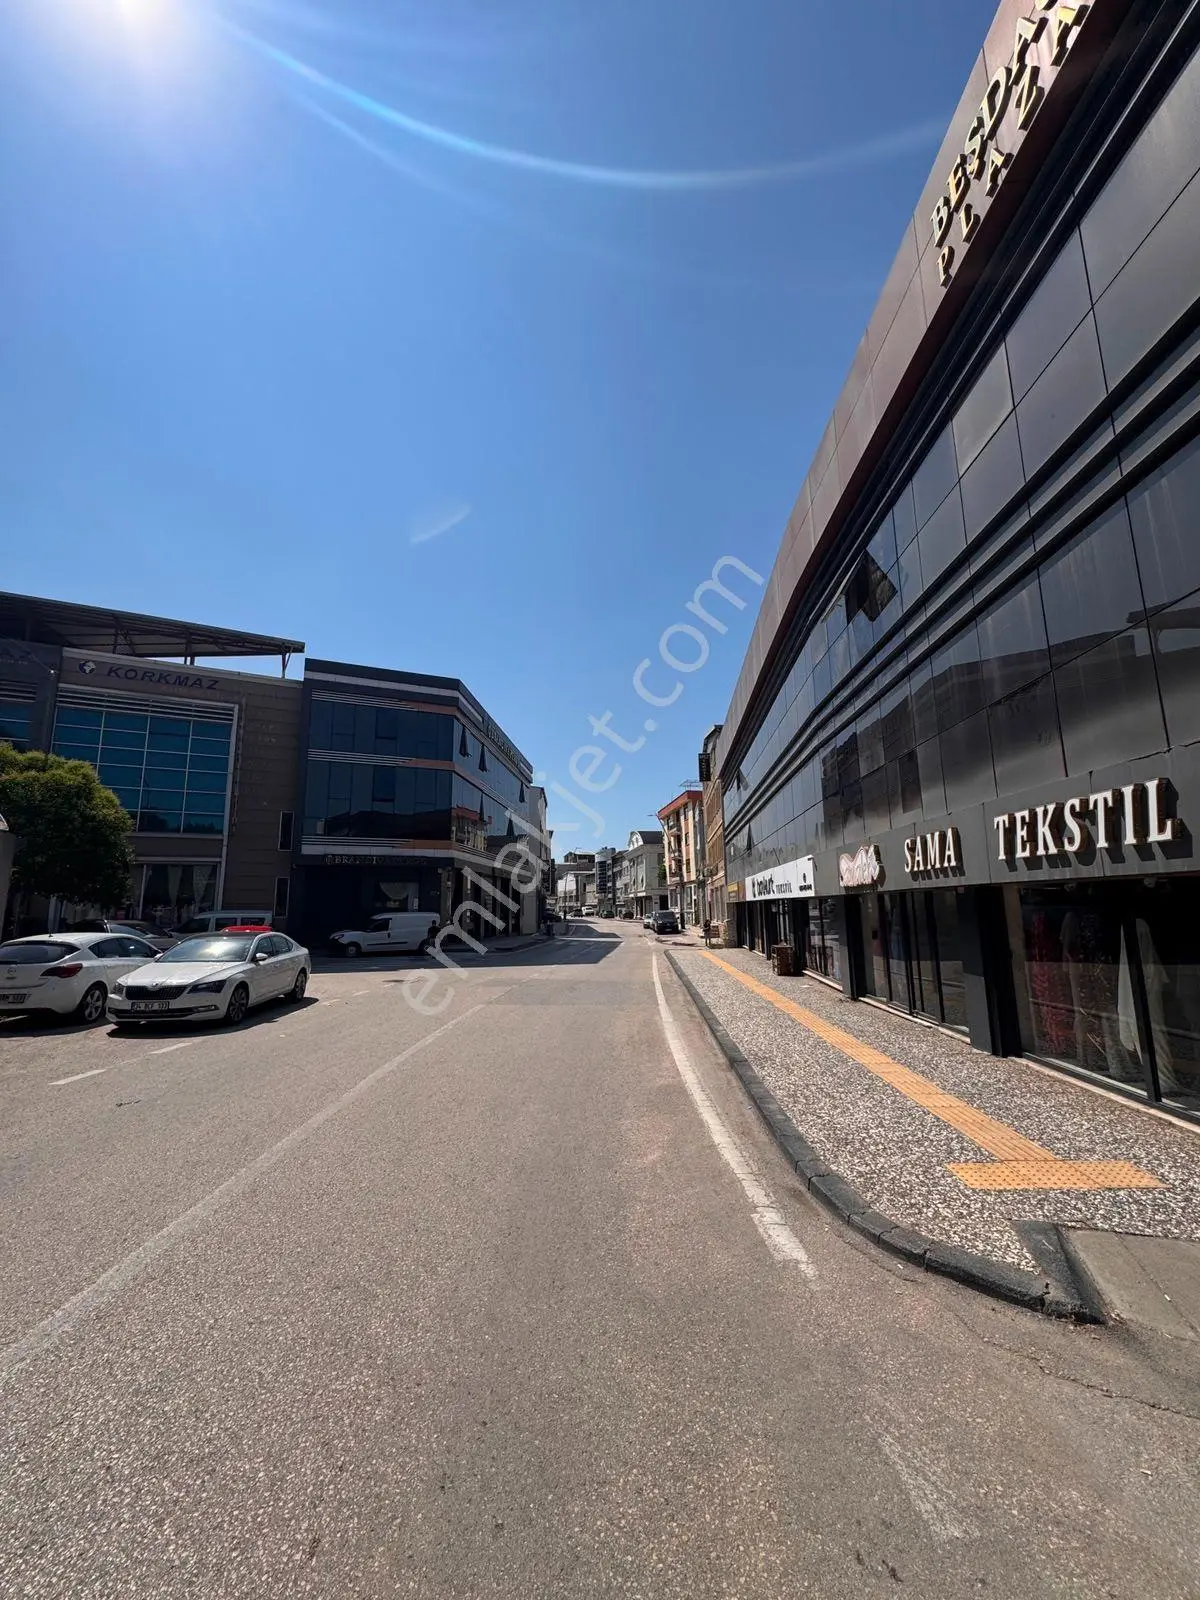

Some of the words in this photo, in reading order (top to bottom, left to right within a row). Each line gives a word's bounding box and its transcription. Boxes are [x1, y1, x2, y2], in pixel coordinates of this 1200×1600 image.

[930, 0, 1058, 249] BESDA
[936, 4, 1091, 289] PLAZA
[106, 665, 220, 691] KORKMAZ
[904, 826, 958, 874] SAMA
[993, 777, 1174, 861] TEKSTIL
